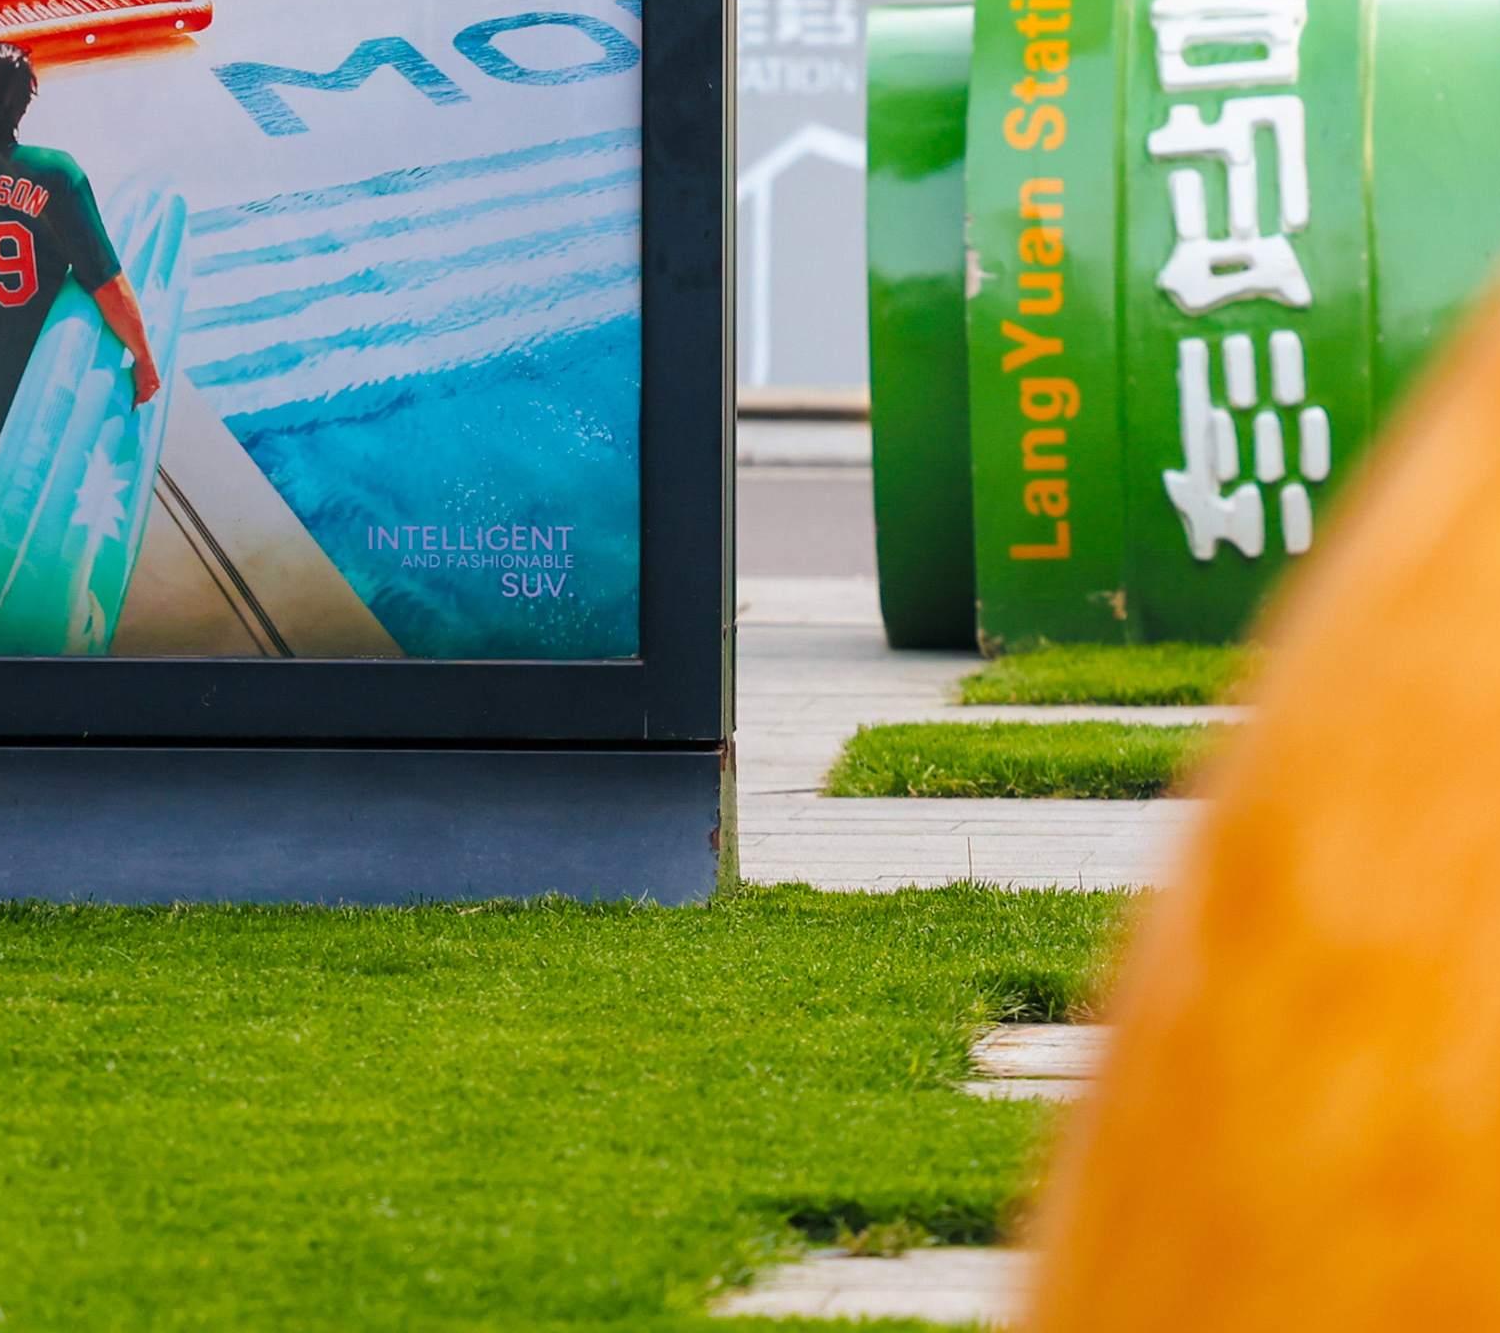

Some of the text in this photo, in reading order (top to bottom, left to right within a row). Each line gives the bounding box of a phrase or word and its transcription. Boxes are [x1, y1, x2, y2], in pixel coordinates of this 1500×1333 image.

[368, 526, 574, 550] INTELLIGENT
[401, 554, 573, 569] AND FASHIONABLE
